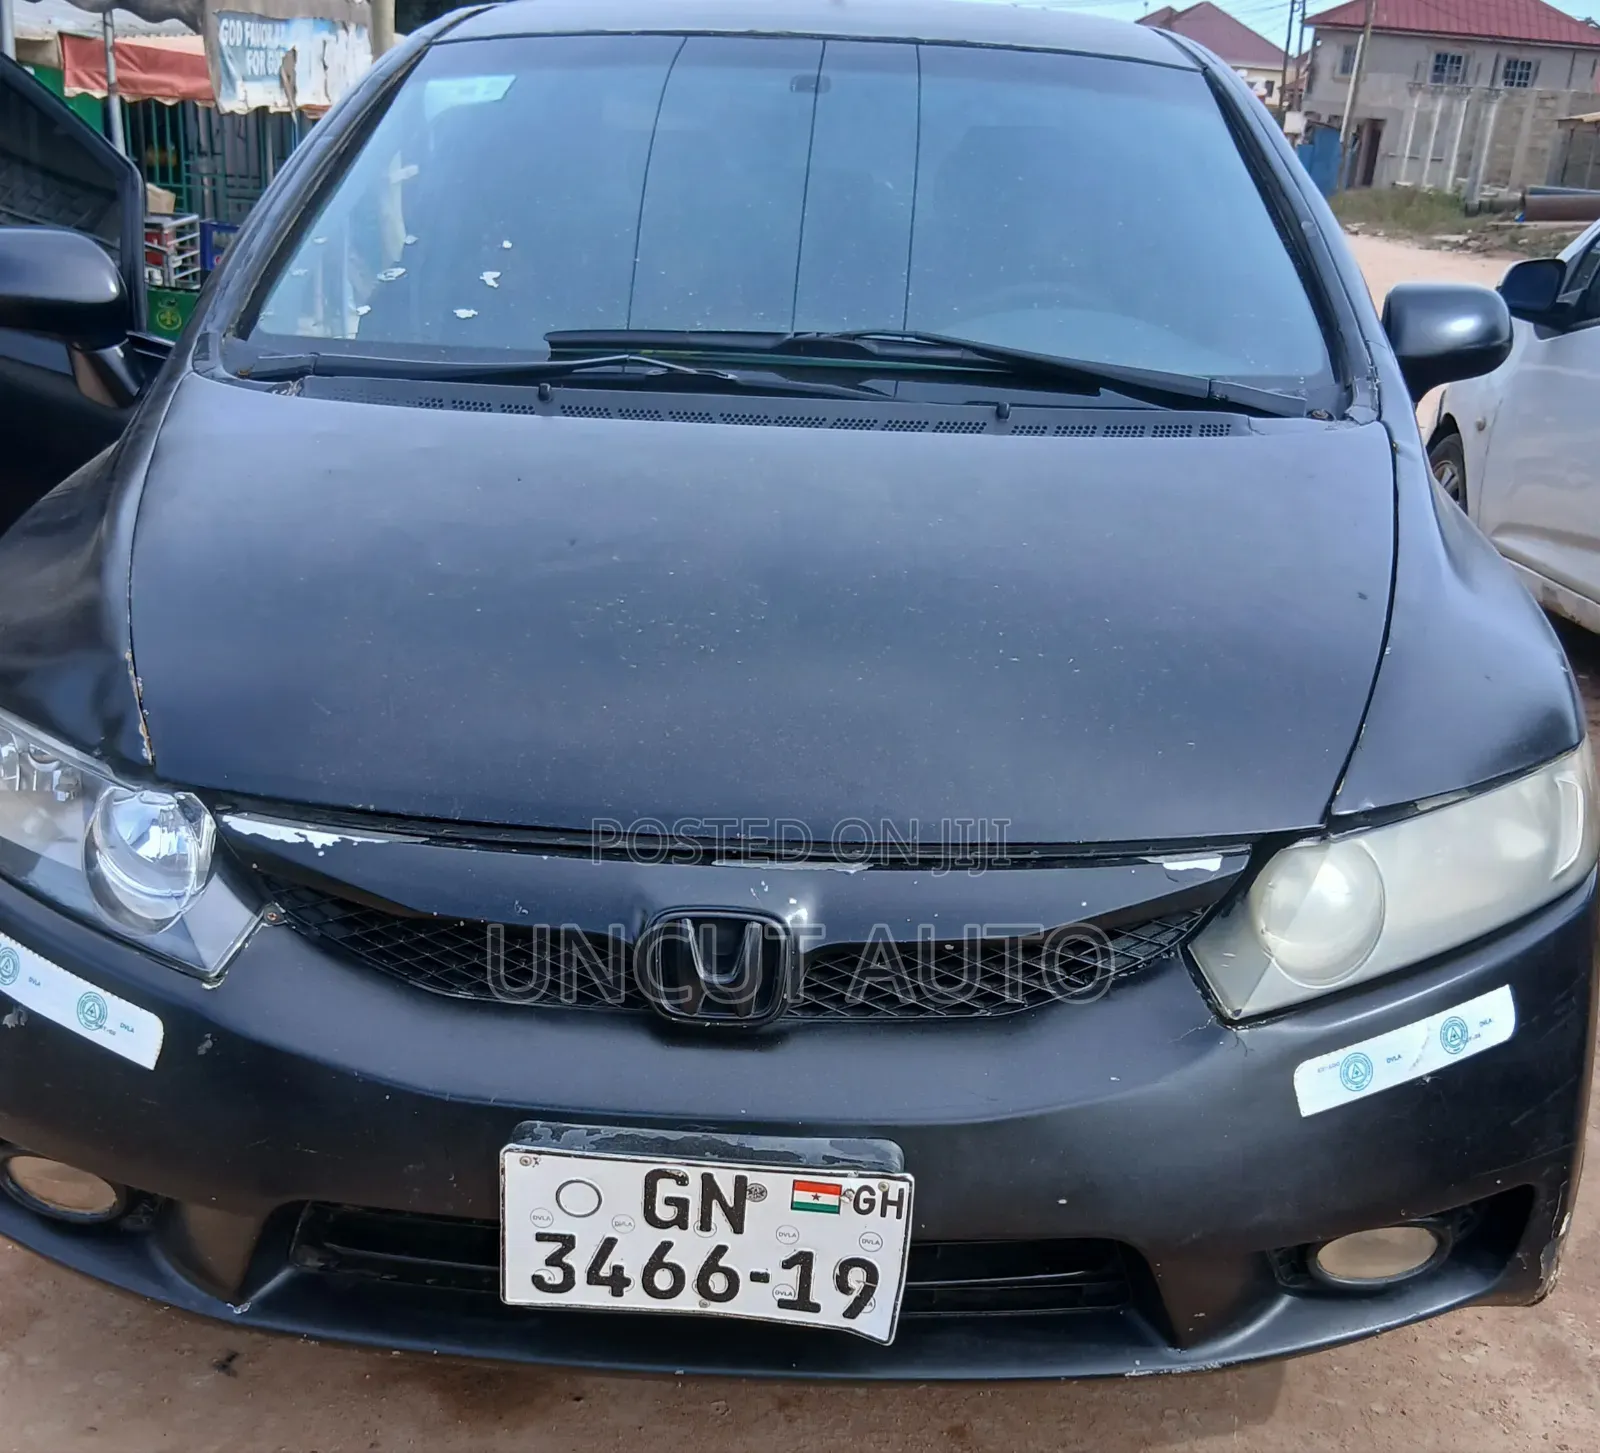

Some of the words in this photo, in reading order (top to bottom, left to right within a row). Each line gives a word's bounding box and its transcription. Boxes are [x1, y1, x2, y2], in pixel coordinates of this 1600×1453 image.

[219, 18, 243, 46] GOD
[246, 50, 266, 76] FOR
[643, 1168, 749, 1235] GN
[852, 1184, 905, 1220] GH
[778, 1231, 797, 1239] DVLA
[861, 1238, 881, 1246] DVLA
[531, 1232, 879, 1320] 3466-19
[774, 1289, 793, 1297] DVLA
